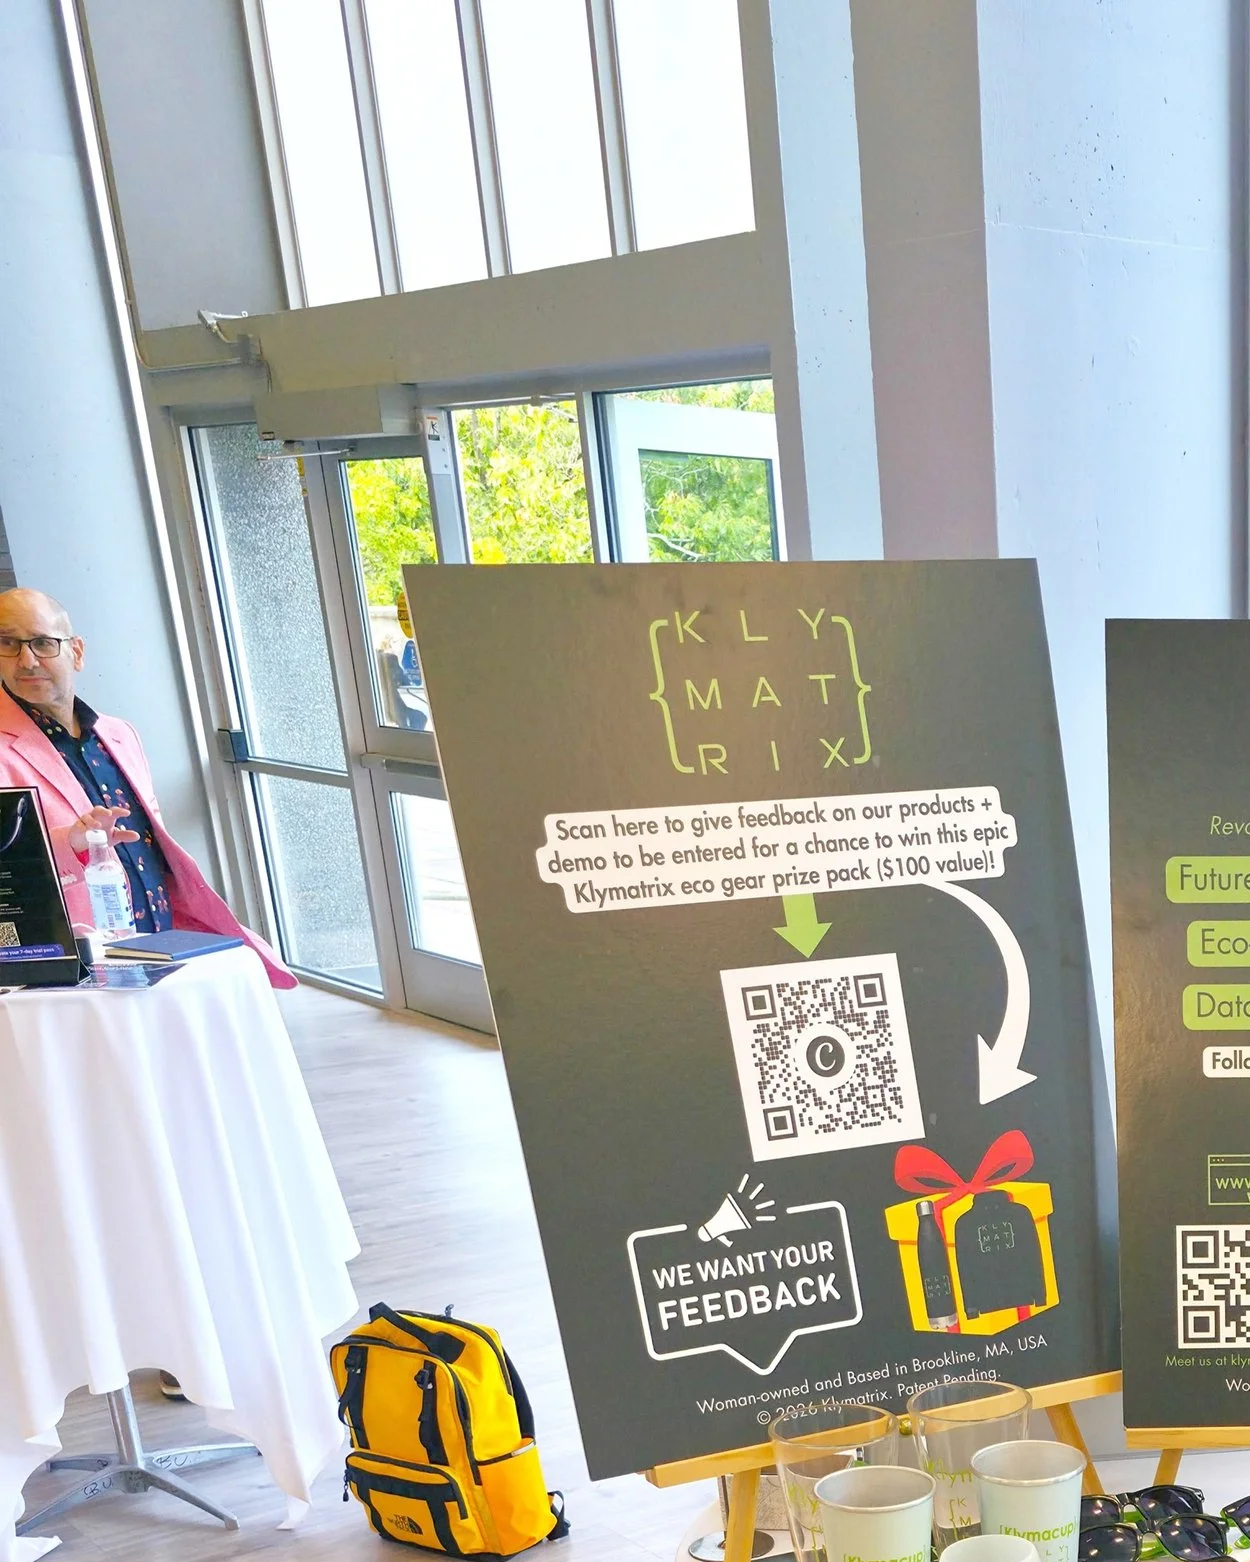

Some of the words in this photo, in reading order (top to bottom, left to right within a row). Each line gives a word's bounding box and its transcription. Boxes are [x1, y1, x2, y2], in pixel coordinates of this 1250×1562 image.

[555, 819, 606, 840] Scan
[611, 814, 659, 837] here
[664, 815, 685, 833] to
[690, 810, 733, 838] give
[737, 801, 827, 828] feedback
[832, 806, 856, 822] on
[862, 802, 893, 820] our
[899, 793, 975, 823] products
[980, 797, 993, 811] +
[547, 850, 607, 874] demo
[613, 851, 634, 869] to
[638, 844, 666, 867] be
[671, 837, 746, 864] entered
[751, 836, 780, 858] for
[785, 841, 799, 856] a
[804, 832, 870, 855] chance
[875, 831, 893, 849] to
[898, 826, 932, 847] win
[936, 822, 968, 844] this
[973, 820, 1009, 846] epic
[573, 876, 676, 909] Klymatrix
[680, 878, 715, 896] eco
[721, 874, 766, 898] gear
[772, 865, 821, 894] prize
[826, 858, 872, 889] pack
[876, 854, 931, 882] ($100
[935, 849, 996, 874] value)!
[652, 1263, 694, 1290] WE
[696, 1251, 768, 1282] WANT
[770, 1240, 835, 1270] YOUR
[657, 1272, 842, 1331] FEEDBACK
[696, 1375, 811, 1415] Woman-owned
[814, 1370, 843, 1392] and
[846, 1363, 890, 1386] Based
[895, 1362, 908, 1376] in
[912, 1348, 980, 1373] Brookline,
[985, 1343, 1014, 1359] MA,
[1018, 1334, 1048, 1352] USA
[1165, 1355, 1195, 1367] Meet
[1199, 1357, 1212, 1367] us
[1215, 1355, 1227, 1367] at
[756, 1409, 772, 1425] ©
[897, 1378, 939, 1396] Patent
[943, 1367, 1002, 1384] Pending.
